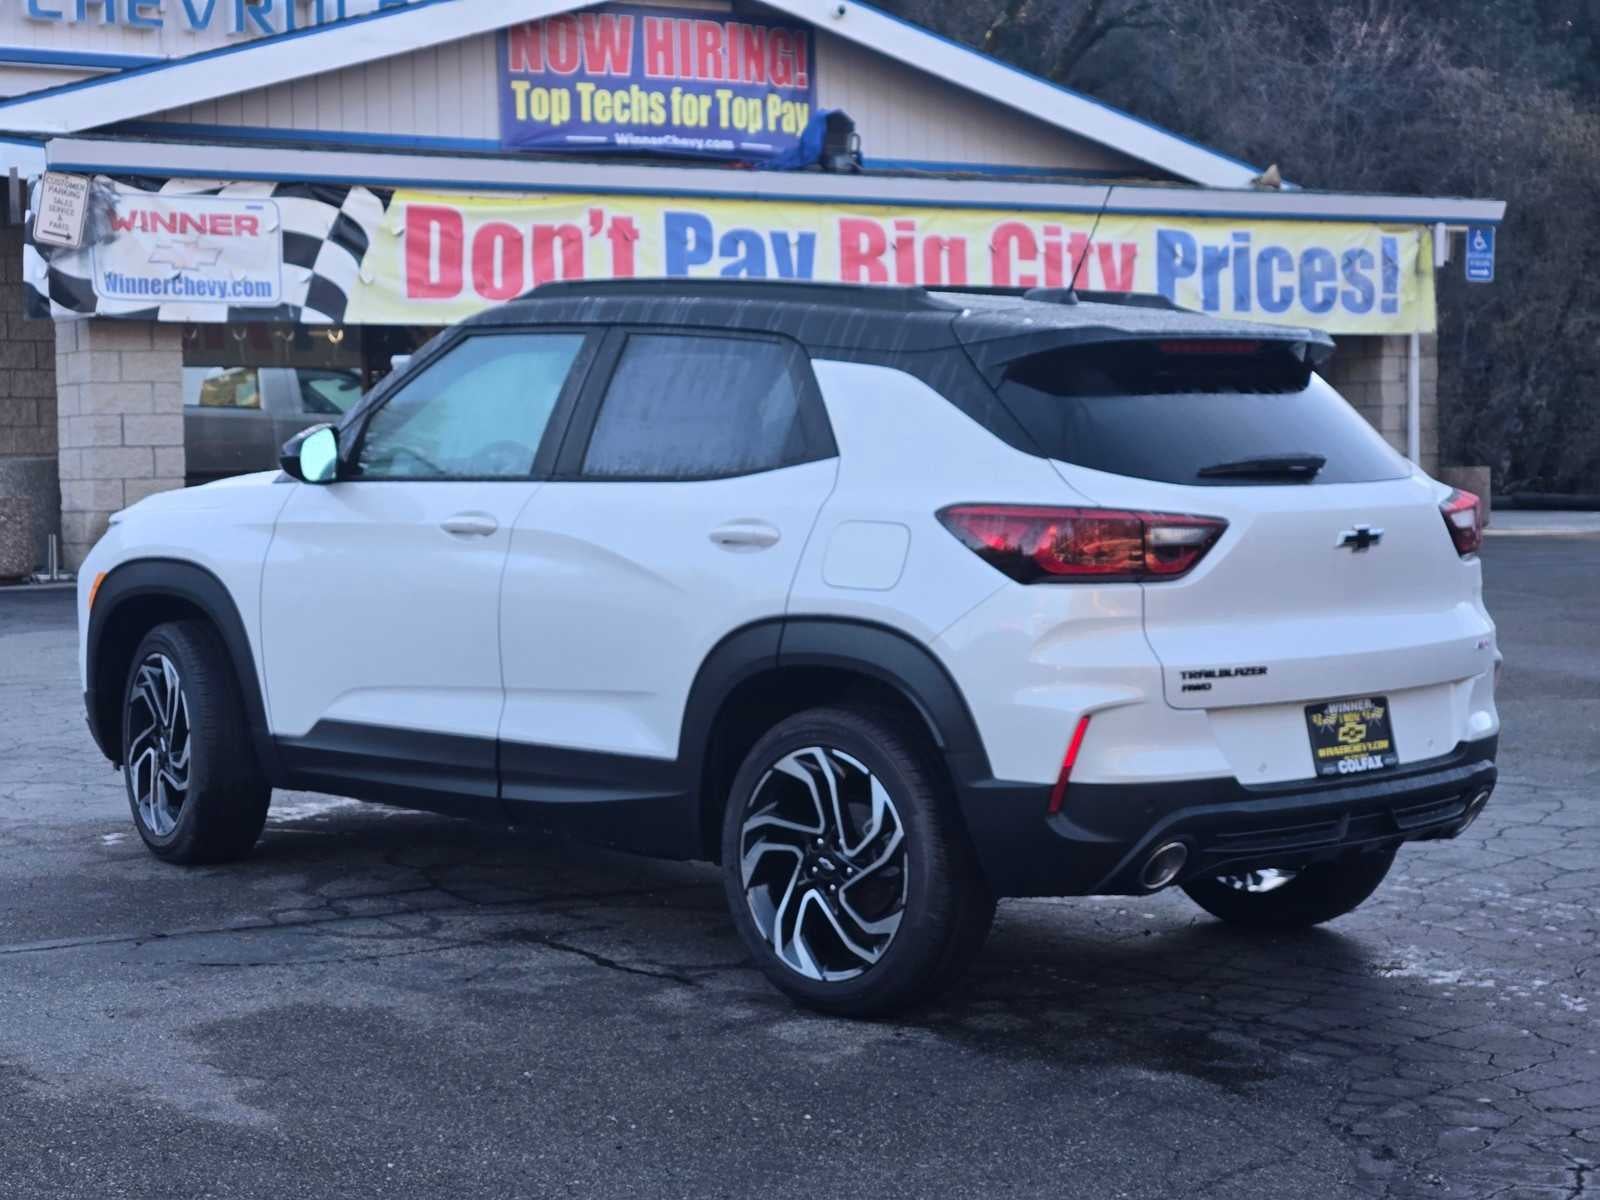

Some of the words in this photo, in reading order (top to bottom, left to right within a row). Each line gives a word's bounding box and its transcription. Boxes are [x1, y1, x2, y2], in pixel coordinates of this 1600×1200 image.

[27, 0, 409, 34] HEVRO
[508, 14, 634, 77] NOW
[643, 17, 809, 89] HIRING!
[511, 80, 571, 126] Top
[576, 82, 667, 126] Techs
[671, 87, 712, 126] for
[715, 89, 763, 133] Top
[766, 93, 810, 136] Pay
[107, 207, 259, 237] WINNER
[405, 204, 639, 300] Don't
[1156, 228, 1399, 317] Prices!
[104, 272, 272, 298] WinnerChevy.com
[1180, 665, 1268, 680] TRAILBLAZER
[1181, 682, 1212, 692] AWD
[1337, 755, 1384, 774] COLFAX
